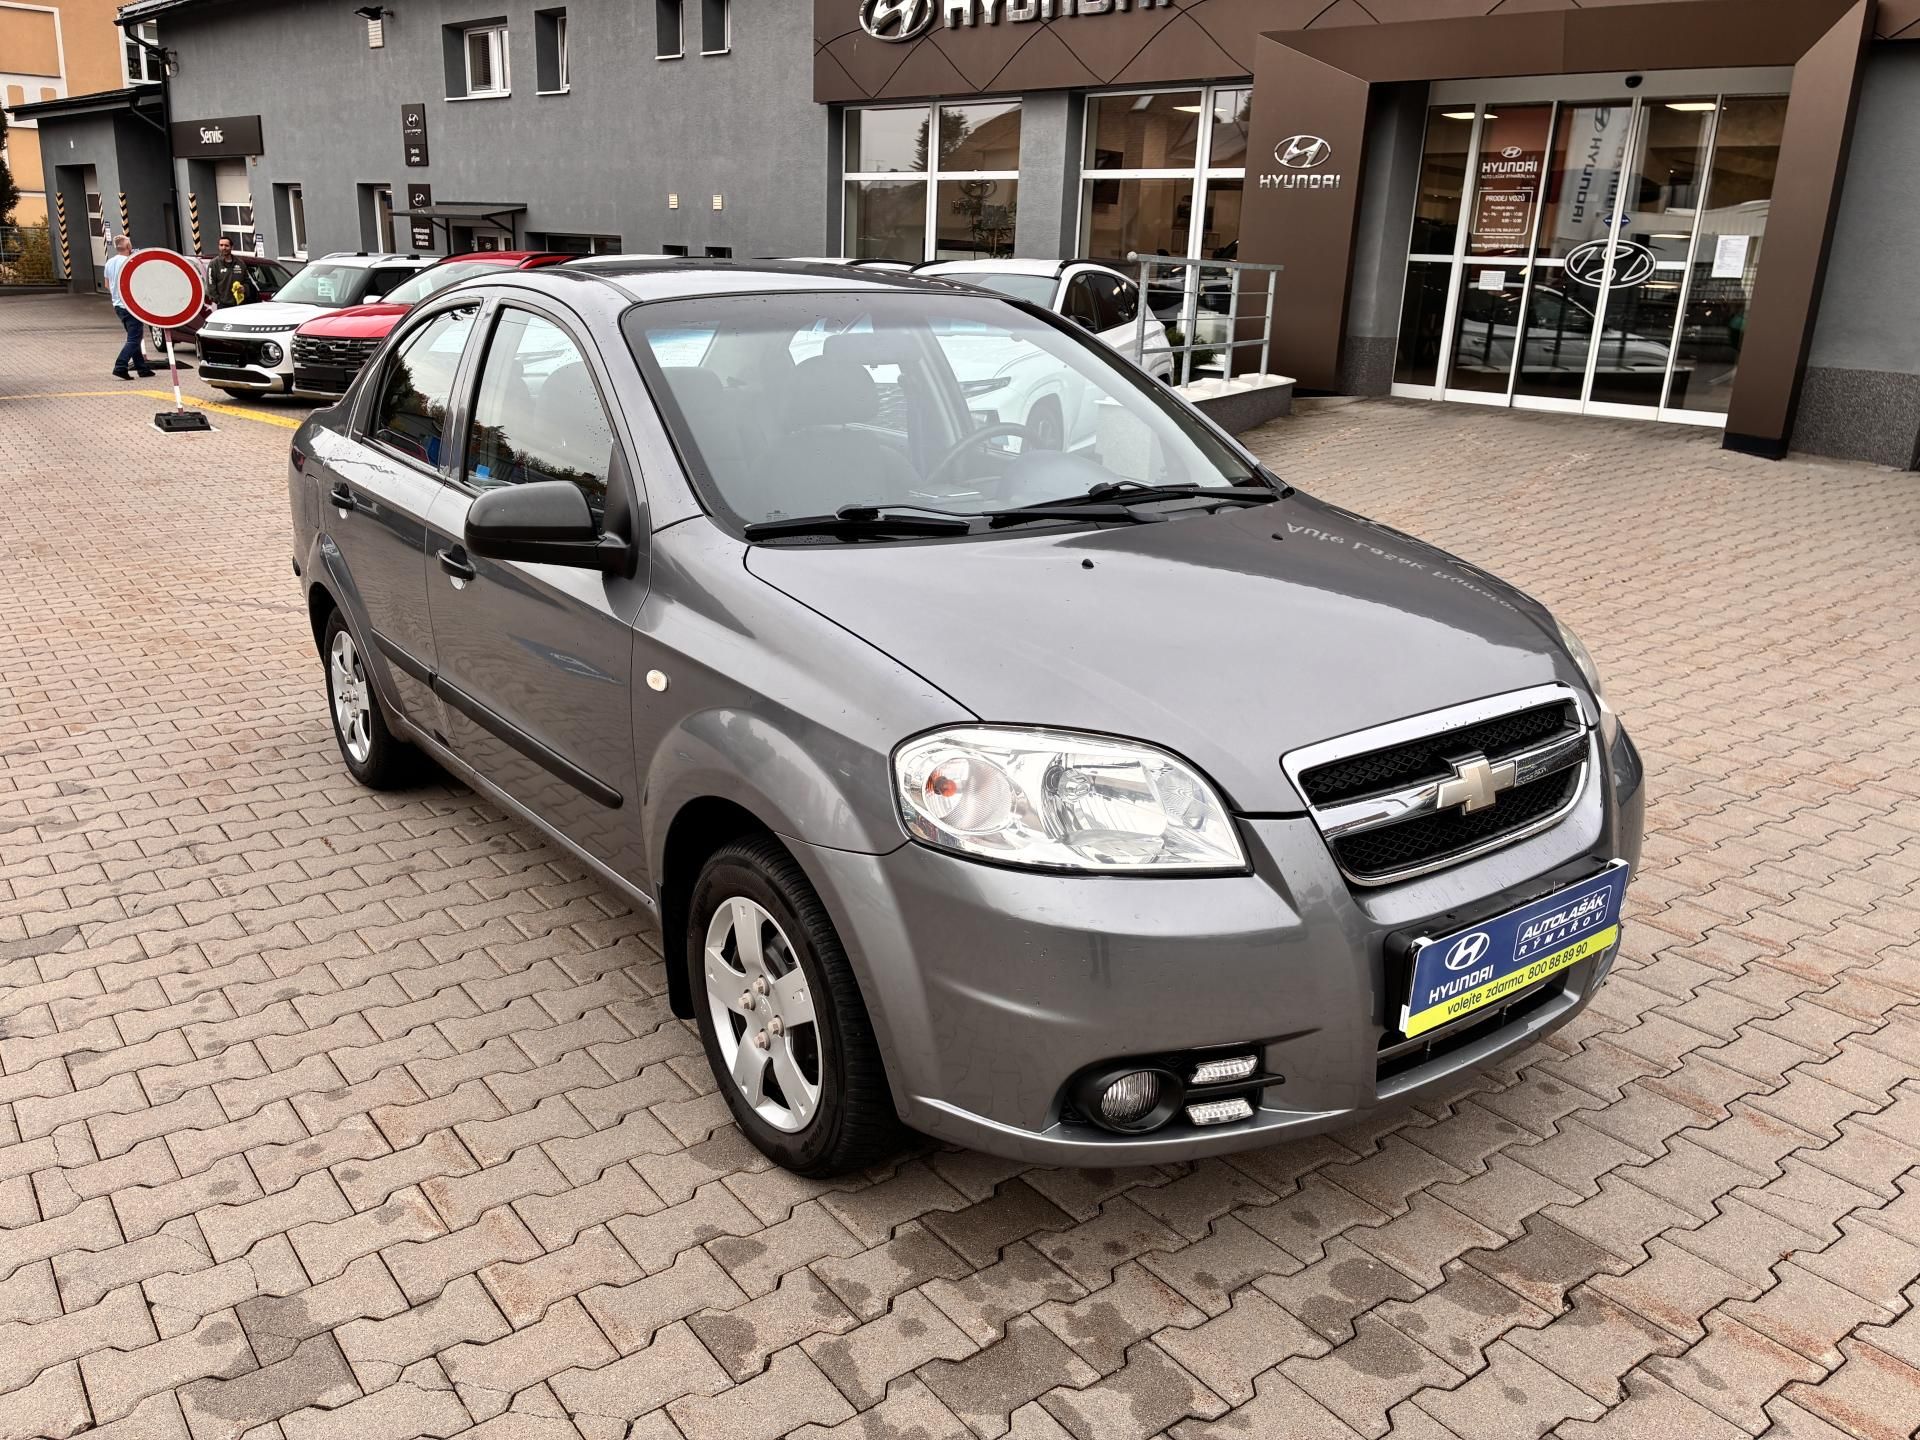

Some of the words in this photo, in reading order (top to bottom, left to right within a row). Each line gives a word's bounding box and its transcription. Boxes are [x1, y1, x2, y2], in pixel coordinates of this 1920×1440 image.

[199, 126, 224, 144] Servis
[1259, 174, 1341, 189] HYUNDAI
[1482, 160, 1538, 173] HYUNDAI
[1570, 137, 1603, 224] HYUNDAI
[1518, 911, 1602, 956] RÝMAŘOV
[1521, 893, 1606, 941] AUTOLAŠÁK
[1428, 964, 1494, 1005] HYUNDAI
[1447, 991, 1482, 1015] volejte
[1485, 973, 1524, 999] zdarma
[1527, 963, 1547, 980] 800
[1548, 954, 1561, 970] 88
[1562, 947, 1574, 964] 89
[1575, 942, 1588, 957] 90
